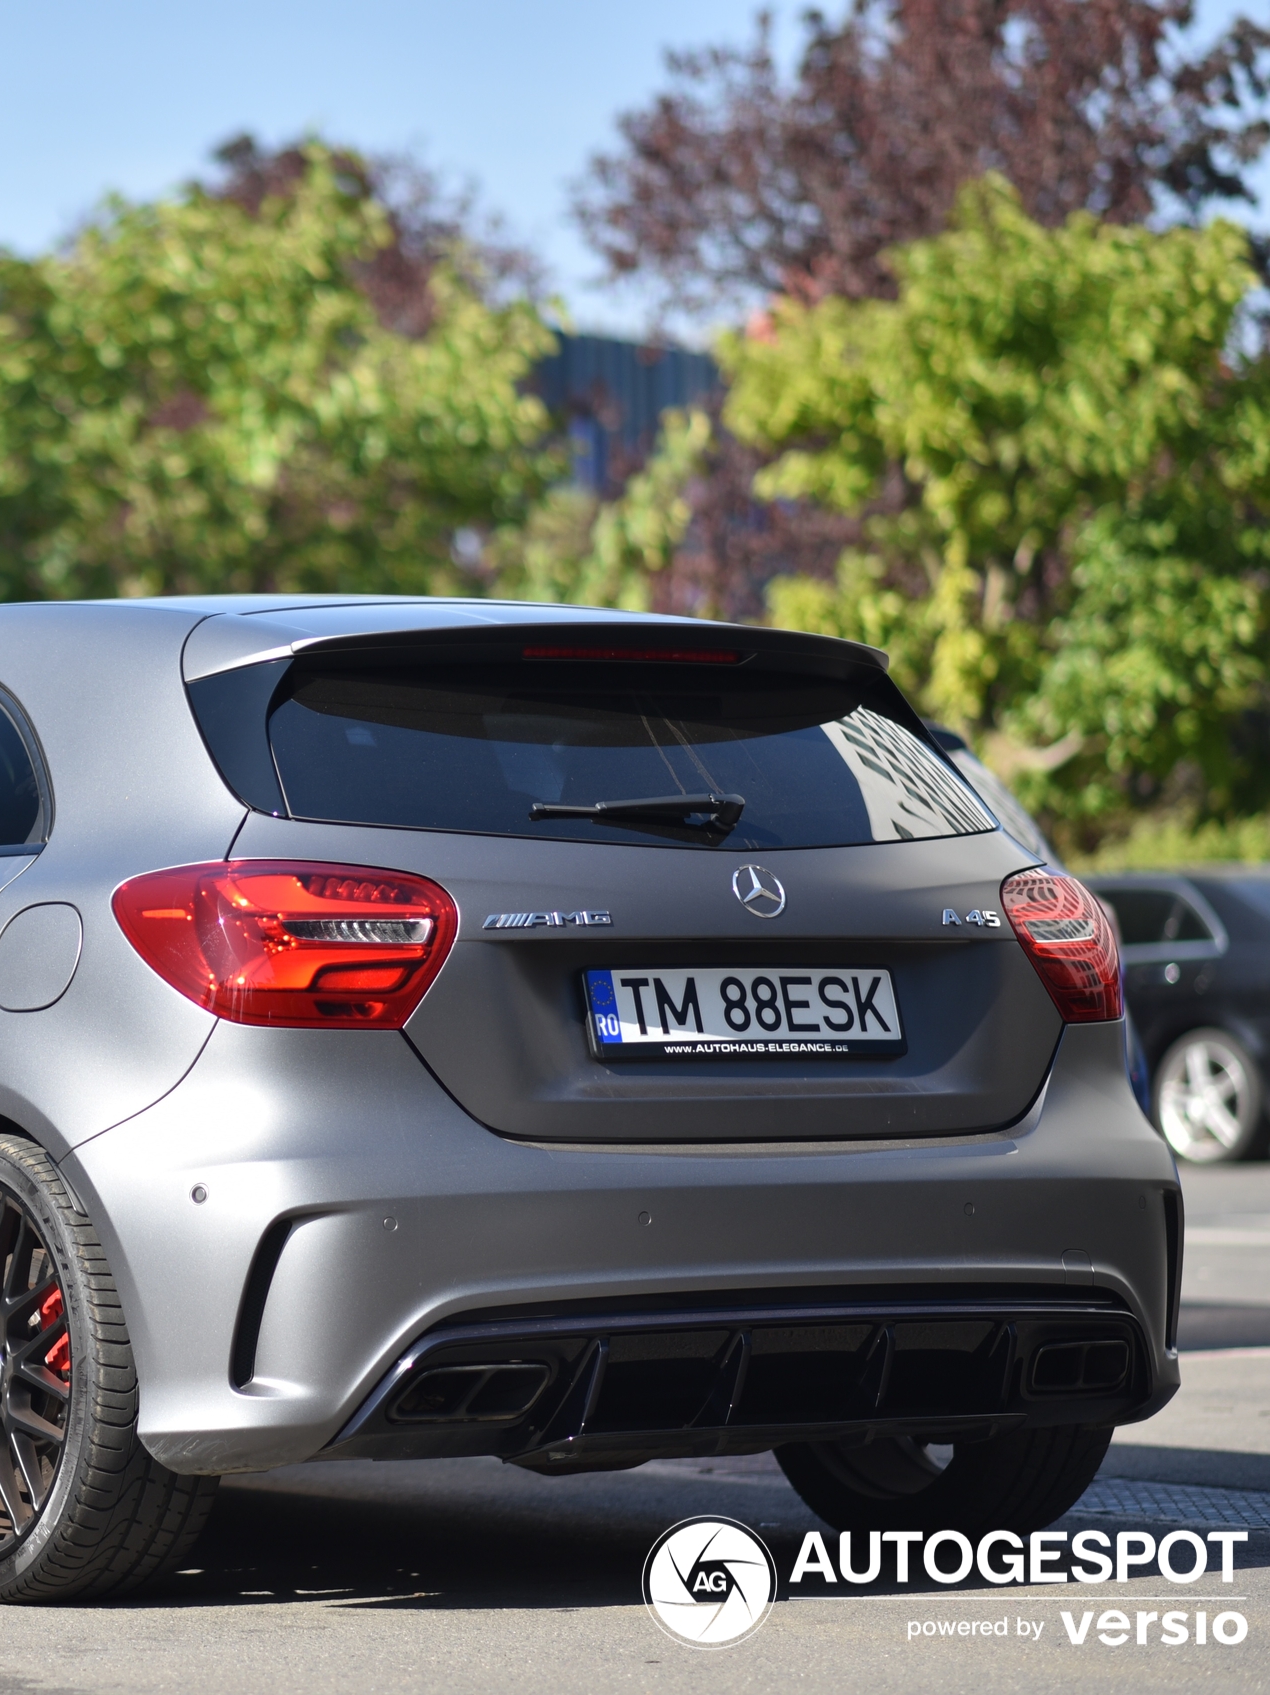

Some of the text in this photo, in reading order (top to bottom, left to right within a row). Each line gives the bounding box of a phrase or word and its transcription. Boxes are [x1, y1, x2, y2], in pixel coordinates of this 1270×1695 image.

[524, 911, 611, 927] AMG
[942, 909, 1001, 927] A 45
[620, 975, 892, 1036] TM 88ESK
[594, 1013, 619, 1037] RO
